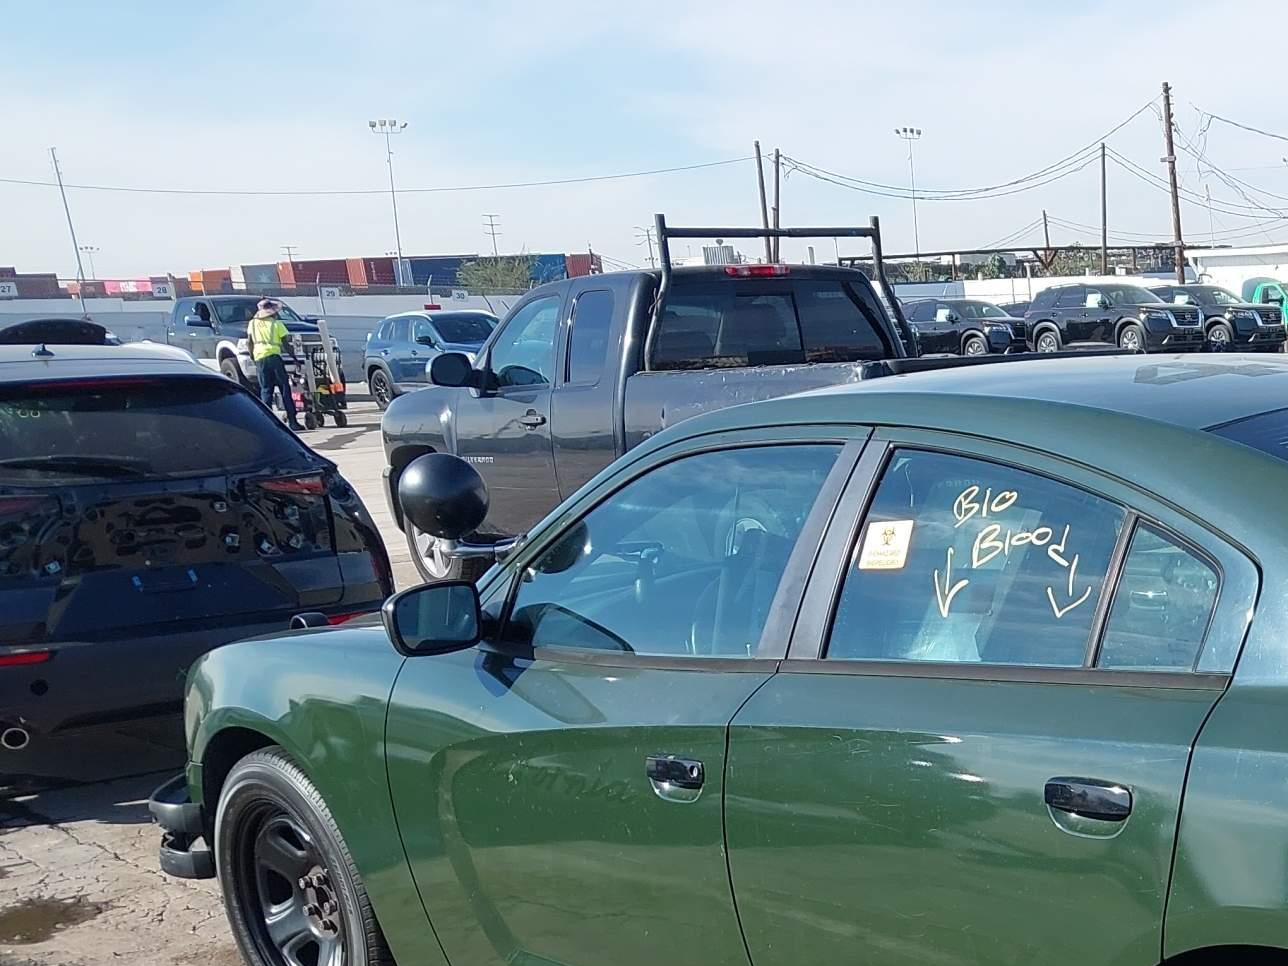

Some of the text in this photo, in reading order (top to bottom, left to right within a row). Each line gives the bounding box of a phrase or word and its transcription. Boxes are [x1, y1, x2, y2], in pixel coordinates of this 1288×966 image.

[0, 285, 11, 293] 27
[156, 286, 168, 295] 28
[325, 289, 336, 297] 29
[455, 291, 465, 300] 30
